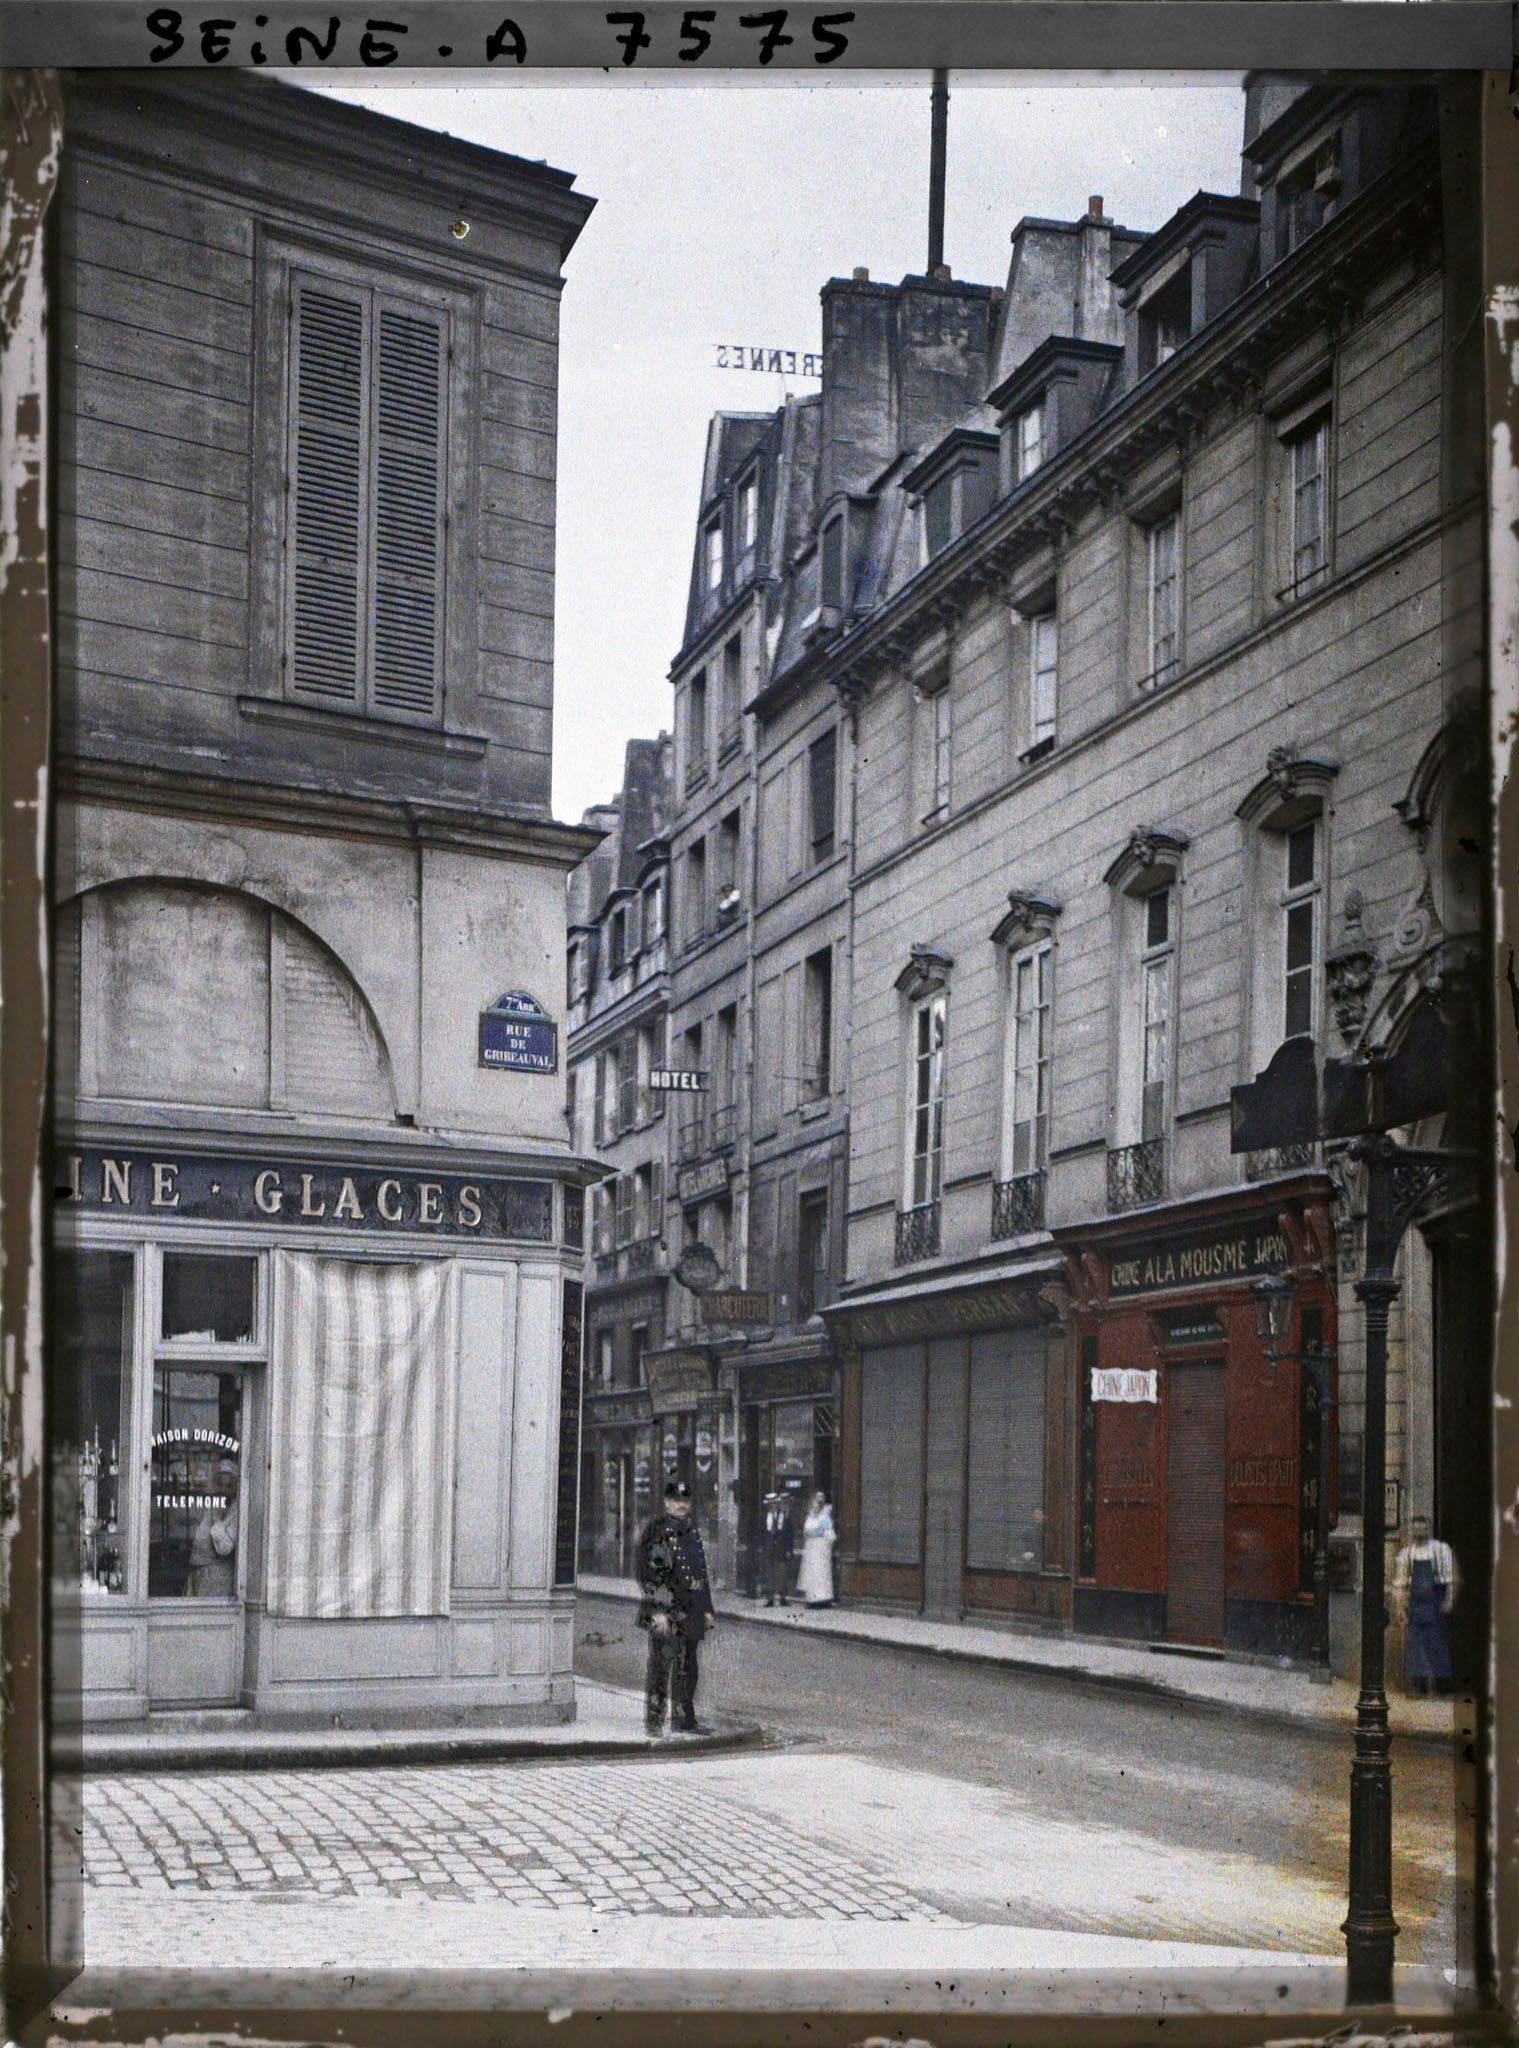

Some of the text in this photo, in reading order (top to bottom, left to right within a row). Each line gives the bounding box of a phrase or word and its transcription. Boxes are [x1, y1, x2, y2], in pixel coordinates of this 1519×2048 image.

[487, 18, 527, 64] A
[605, 9, 856, 66] 7575
[506, 1024, 531, 1037] RUE
[510, 1038, 526, 1050] DE
[484, 1048, 553, 1066] GRIBEAUVAL
[650, 1071, 700, 1090] HOTEL
[254, 1170, 483, 1227] GLACES
[193, 1428, 240, 1453] DORIZON
[156, 1494, 228, 1509] TELEPHONE
